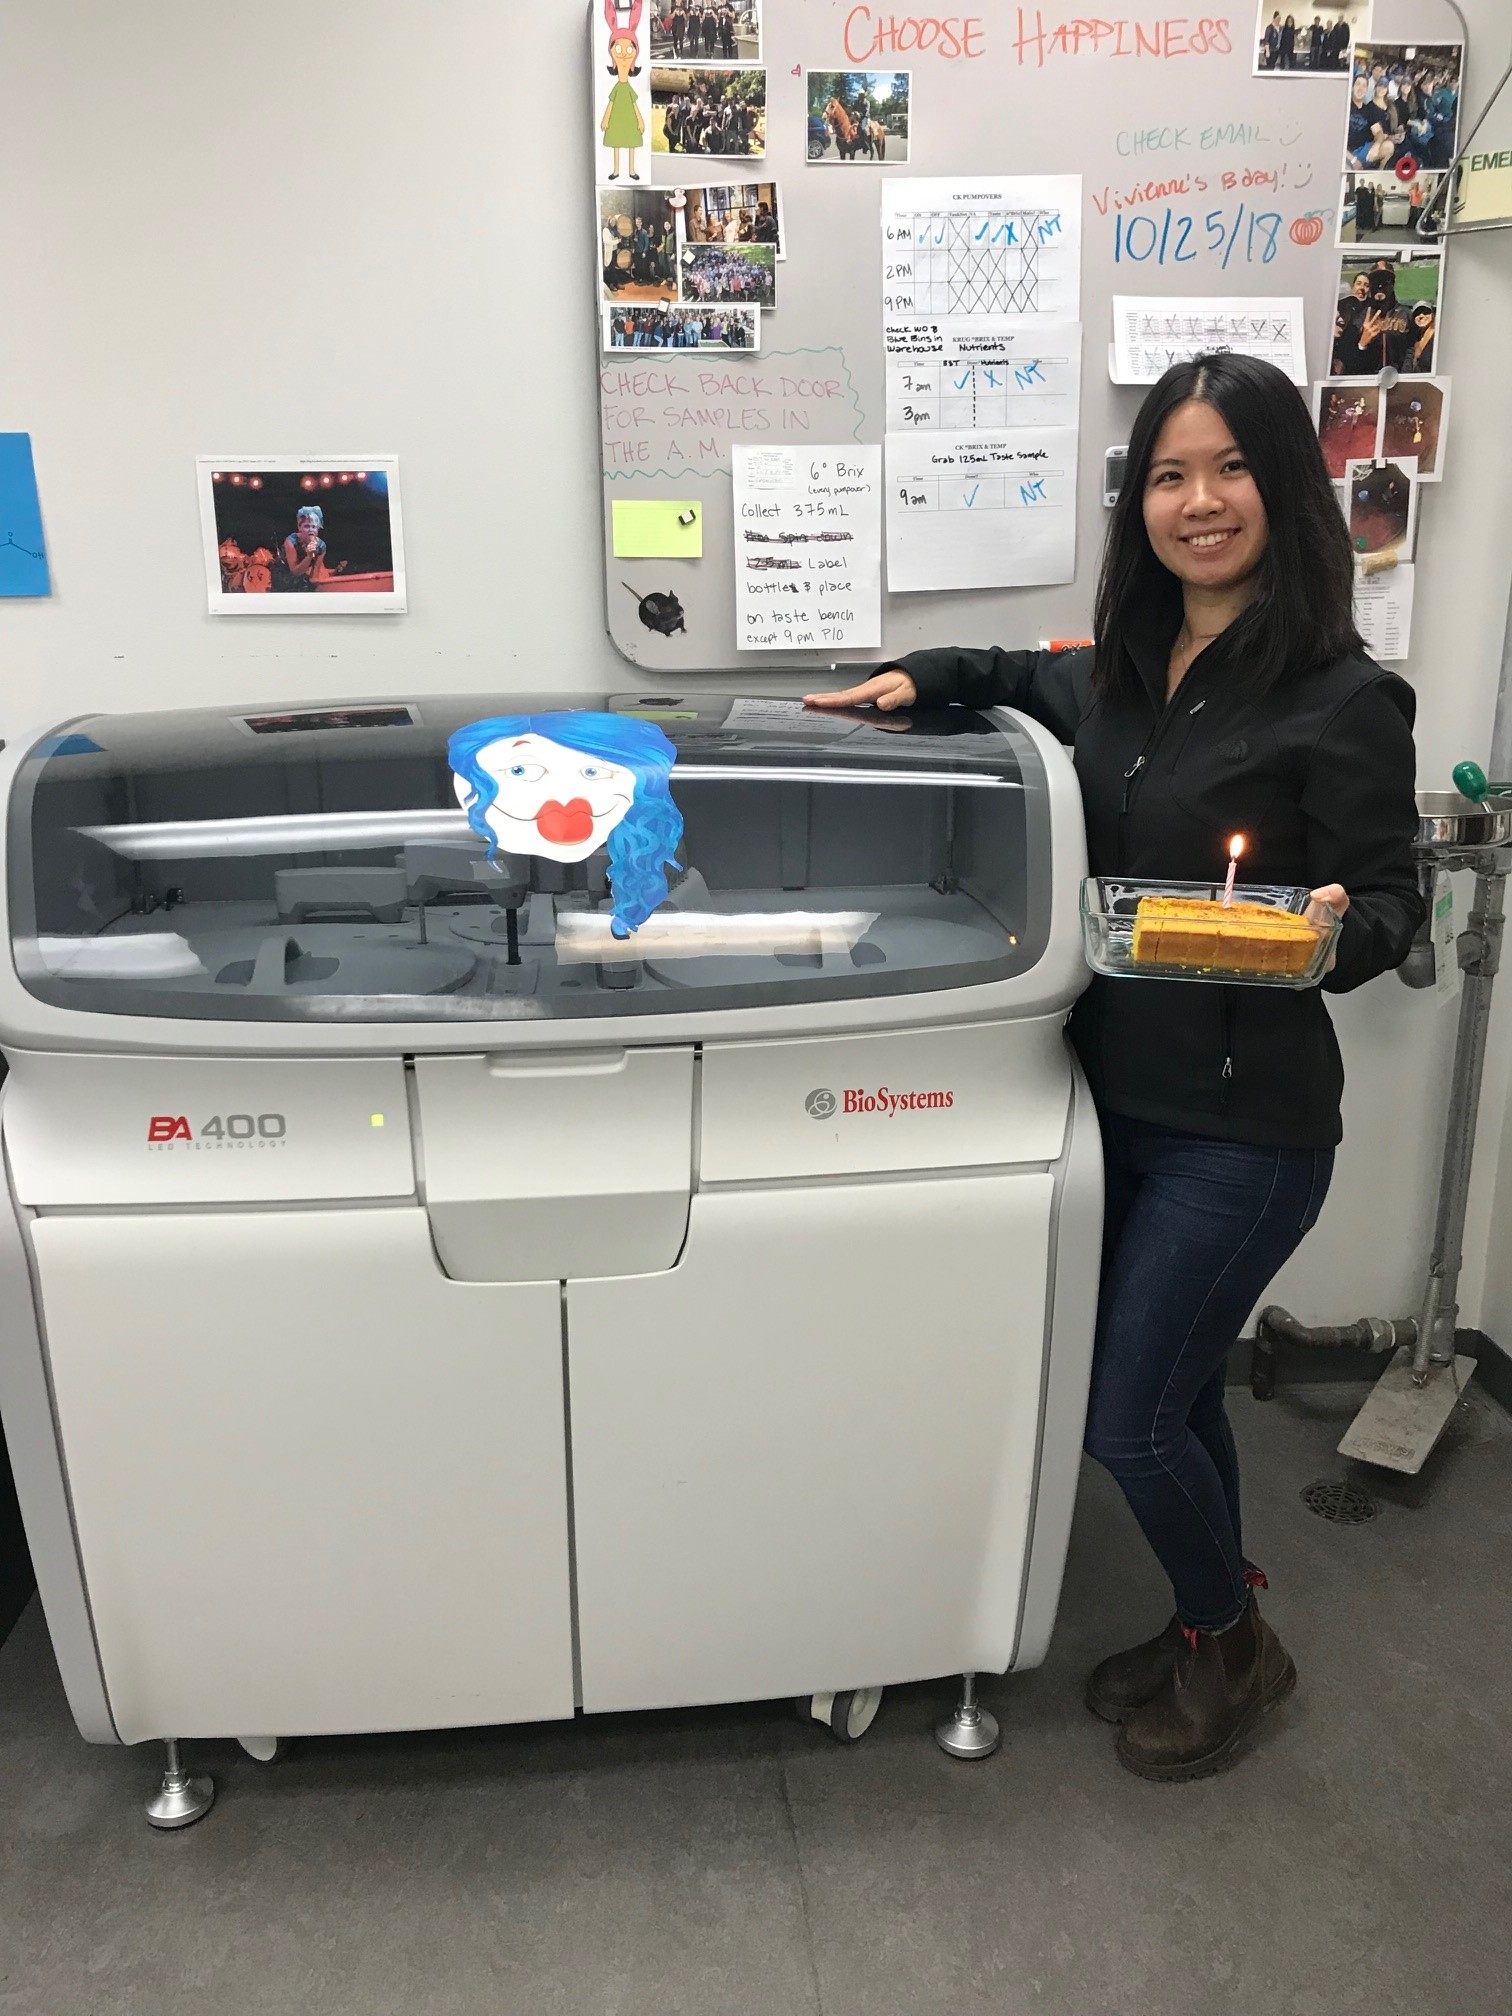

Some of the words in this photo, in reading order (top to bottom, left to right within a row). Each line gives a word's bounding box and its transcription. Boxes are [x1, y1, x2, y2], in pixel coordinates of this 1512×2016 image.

[844, 5, 986, 64] CHOOSE
[1011, 7, 1232, 66] HAPPINESS
[1116, 128, 1192, 157] CHECK
[1199, 123, 1270, 150] EMAIL
[963, 193, 1003, 201] PUMPOVERS
[1092, 174, 1208, 216] Vivienne's
[1113, 203, 1283, 270] 10/25/18
[959, 342, 1006, 351] Nutrients
[600, 371, 689, 397] CHECK
[698, 373, 772, 396] BACK
[780, 377, 845, 398] DOOR
[603, 404, 655, 430] FOR
[663, 407, 771, 430] SAMPLES
[783, 410, 810, 430] IN
[604, 441, 650, 463] THE
[931, 454, 955, 464] Grab
[991, 451, 1014, 461] Taste
[836, 462, 864, 478] Brix
[741, 502, 782, 517] Collect
[808, 556, 848, 569] Label
[818, 580, 852, 596] place
[747, 613, 763, 625] on
[772, 609, 809, 623] taste
[817, 608, 854, 622] bench
[746, 631, 778, 644] except
[842, 1086, 954, 1118] BioSystems
[147, 1115, 193, 1141] BA
[201, 1113, 287, 1140] 400
[148, 1143, 174, 1151] LED
[186, 1140, 287, 1150] TECHNOLOGY
